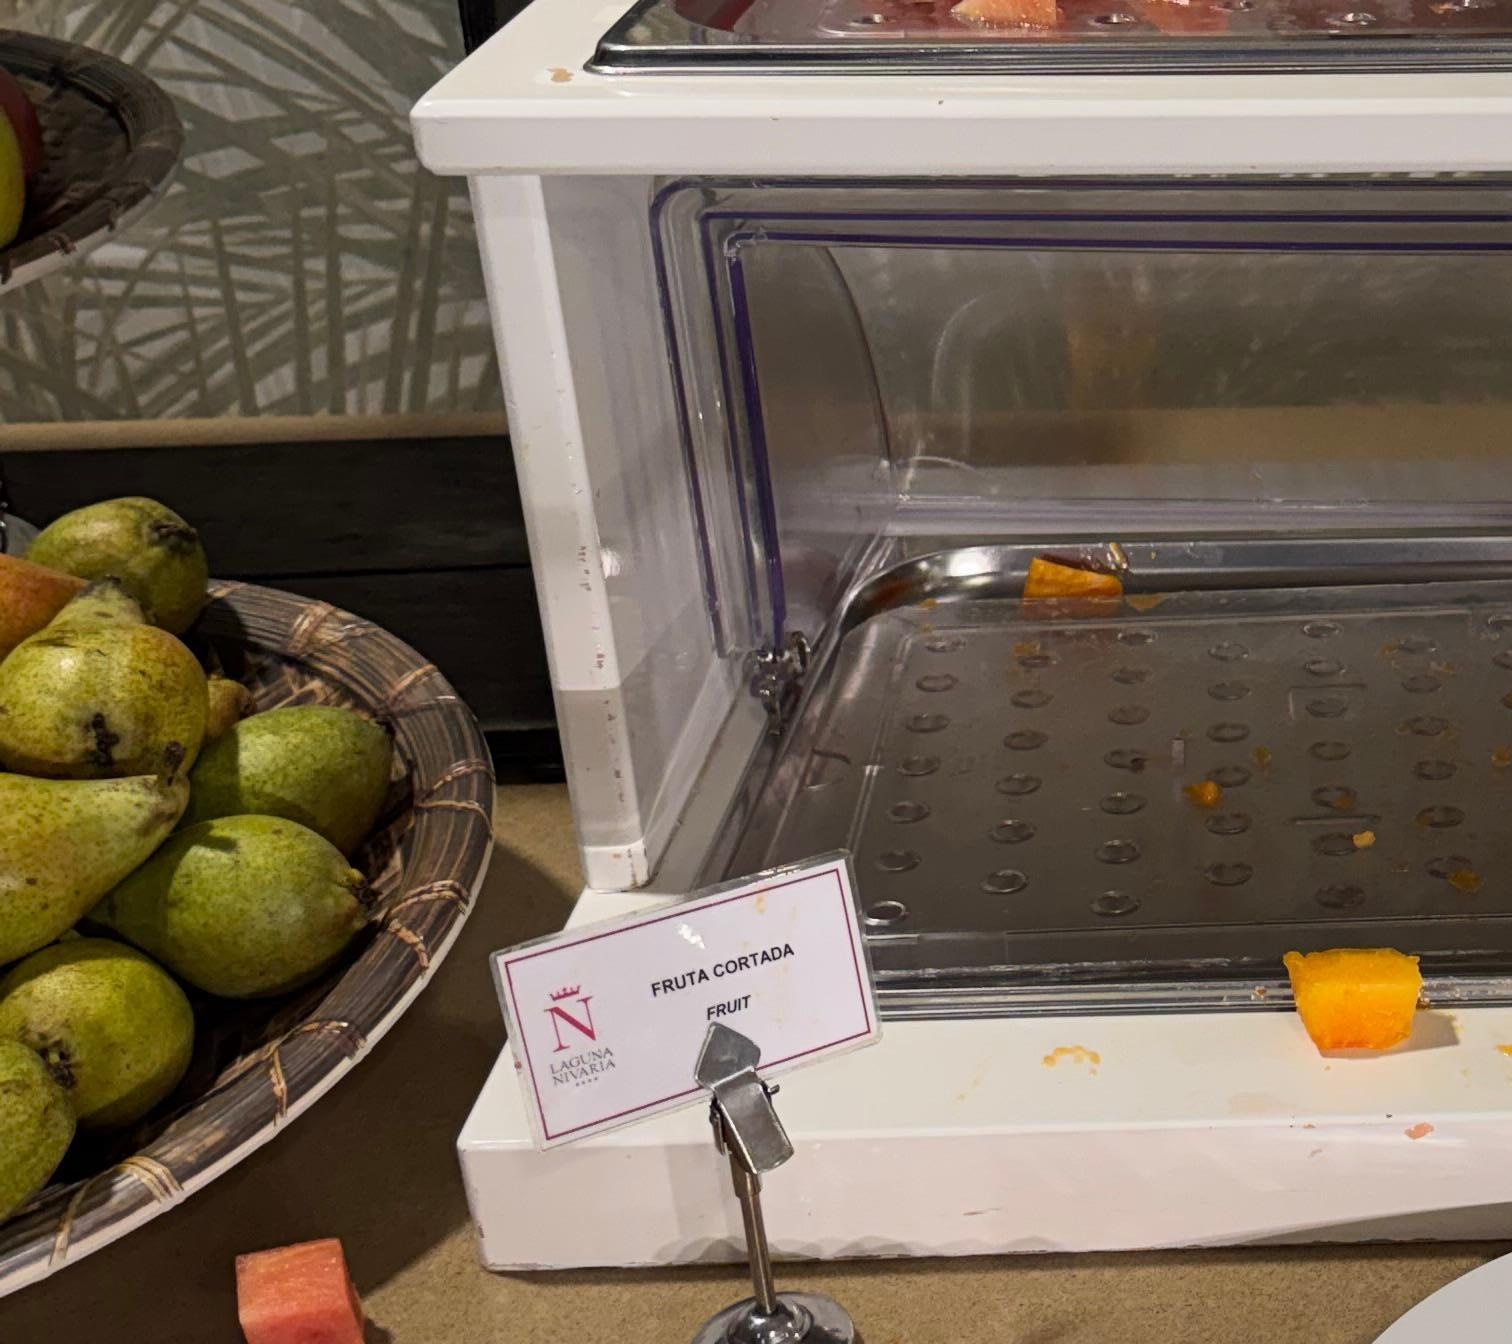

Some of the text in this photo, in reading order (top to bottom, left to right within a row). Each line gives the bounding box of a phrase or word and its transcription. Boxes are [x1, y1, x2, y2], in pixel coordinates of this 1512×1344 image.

[651, 944, 795, 997] FRUTA CORTADA
[706, 994, 751, 1020] FRUIT
[550, 1047, 613, 1074] LAGUNA
[552, 1059, 615, 1086] NIVARIA
